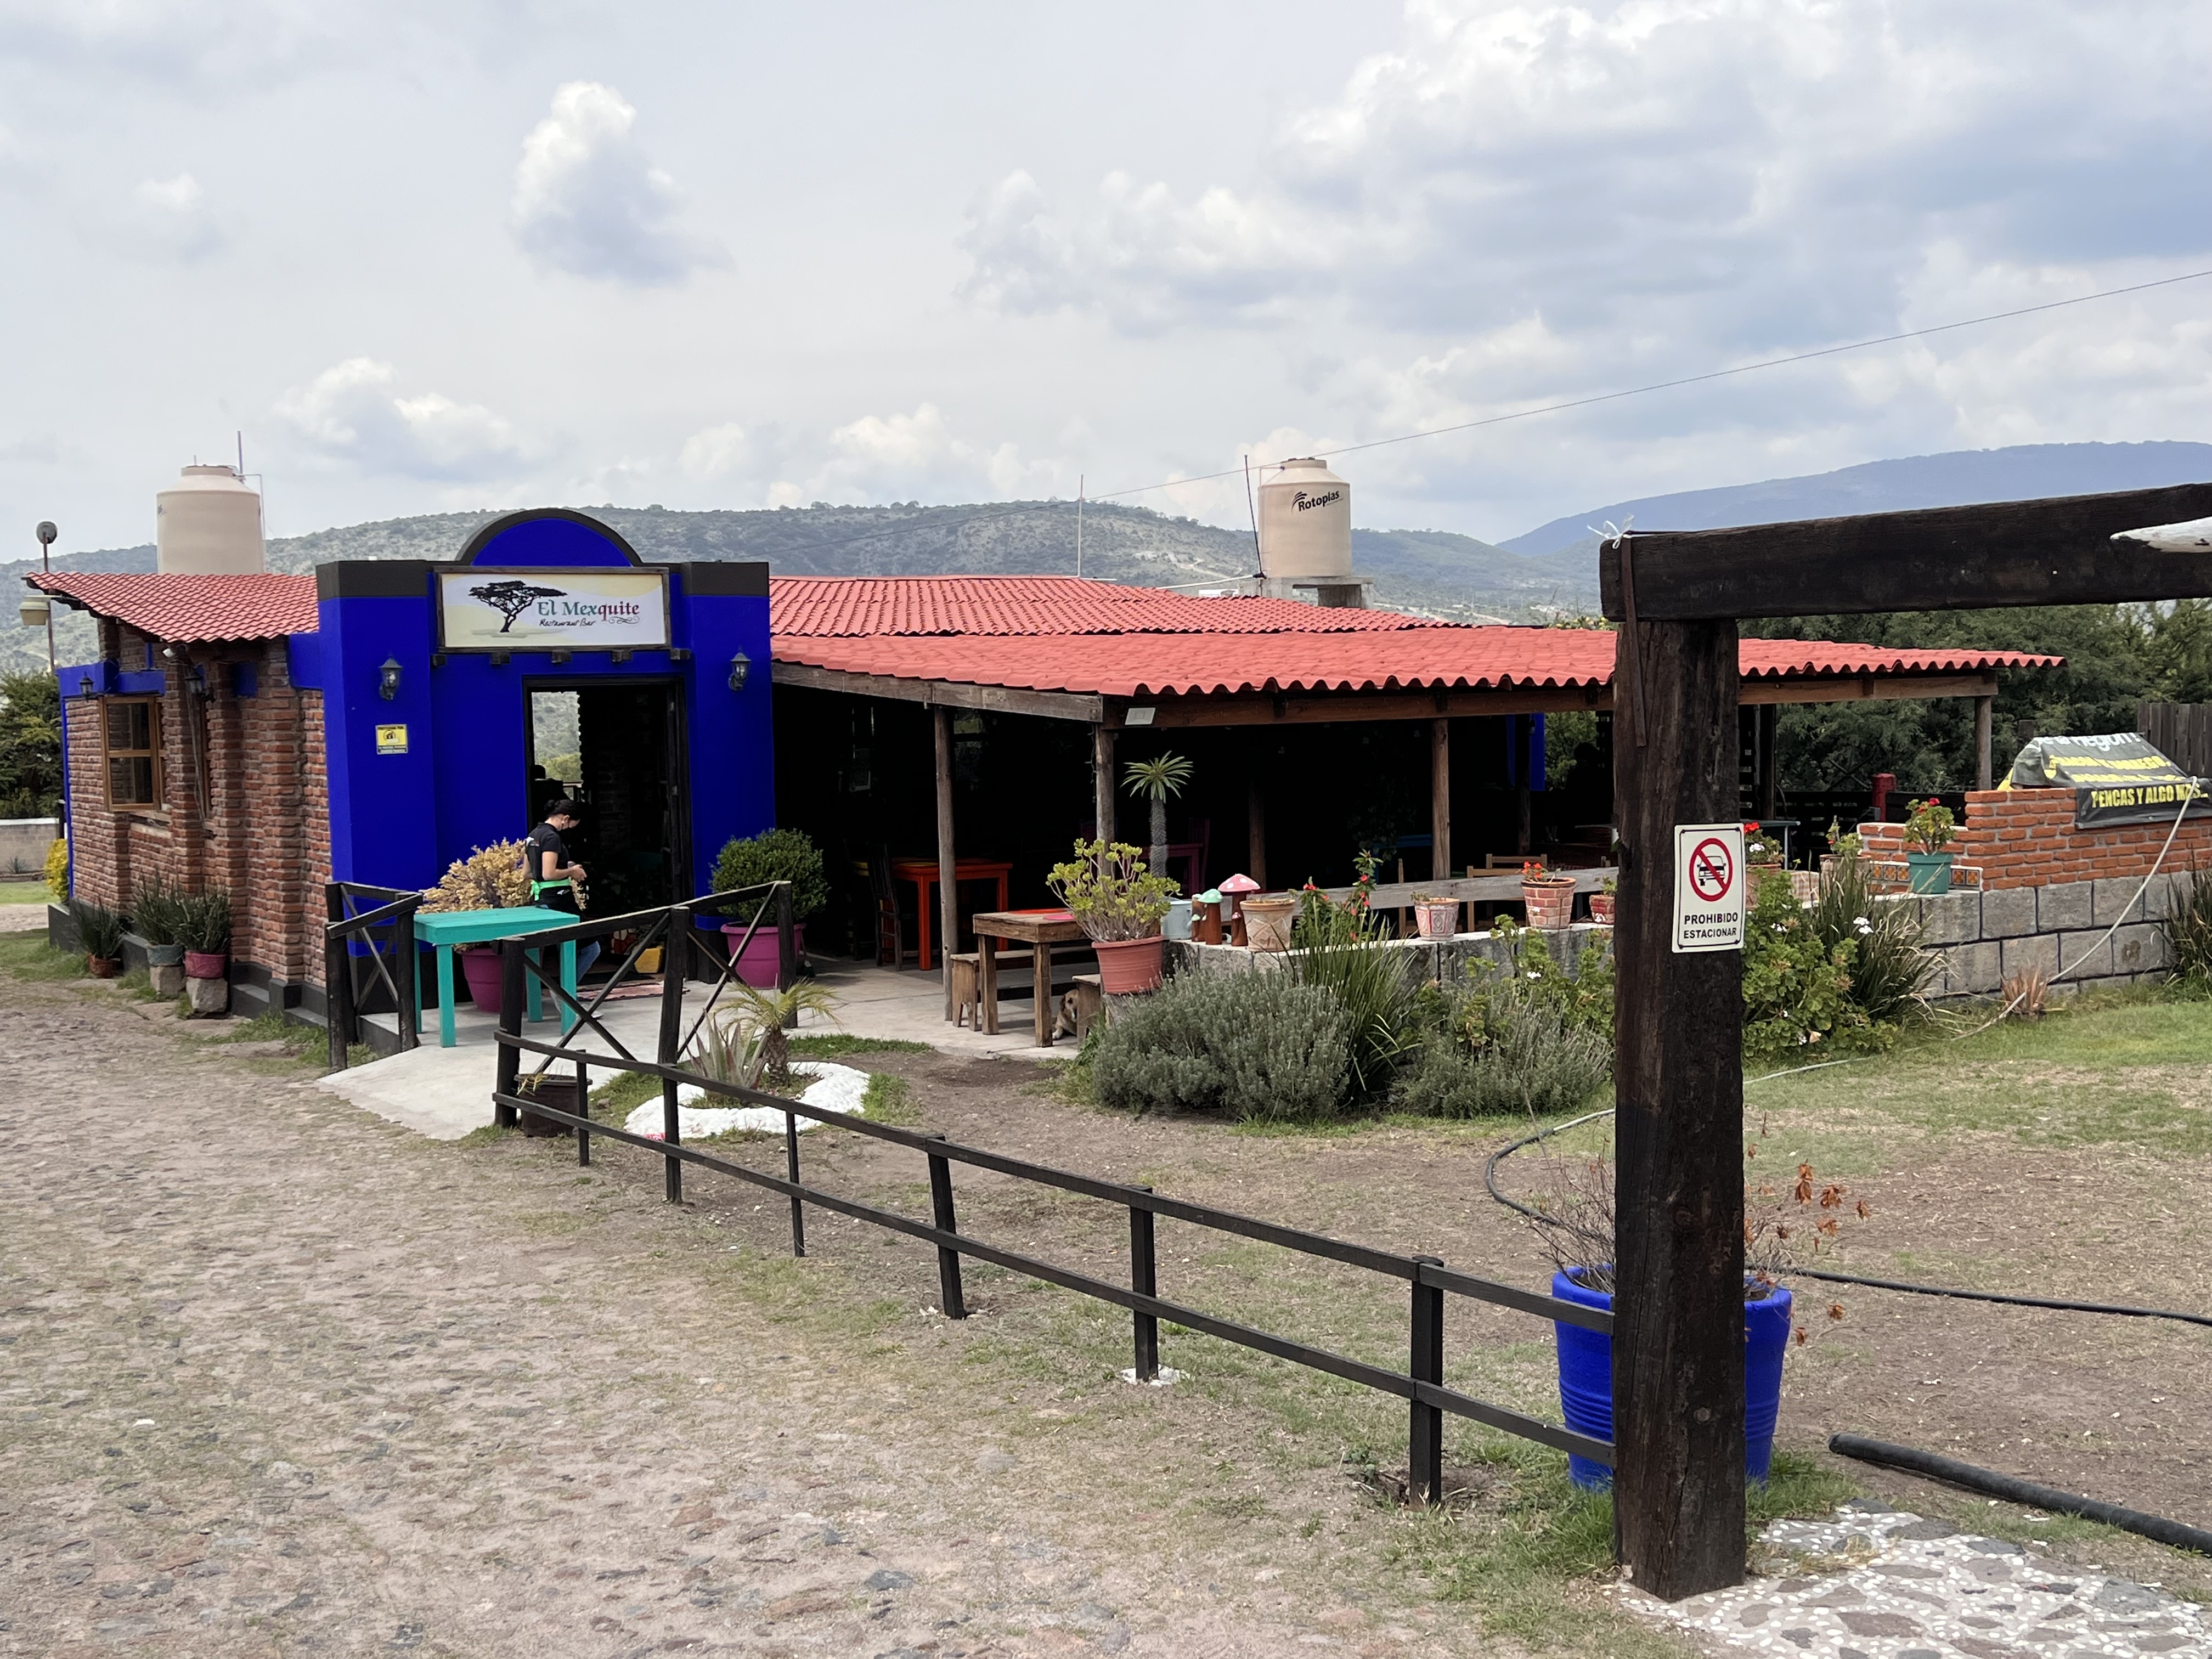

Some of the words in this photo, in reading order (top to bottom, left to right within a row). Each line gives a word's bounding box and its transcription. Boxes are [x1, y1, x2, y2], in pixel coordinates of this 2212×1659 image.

[1298, 490, 1340, 512] Rotoplas
[537, 599, 557, 616] El
[561, 601, 640, 622] Mexquite
[579, 618, 596, 627] Bar
[2091, 788, 2135, 808] PENCAS
[2136, 788, 2143, 805] Y
[2145, 785, 2174, 804] ALGO
[1684, 912, 1739, 925] PROHIBIDO
[1683, 927, 1737, 939] ESTACIONAR
